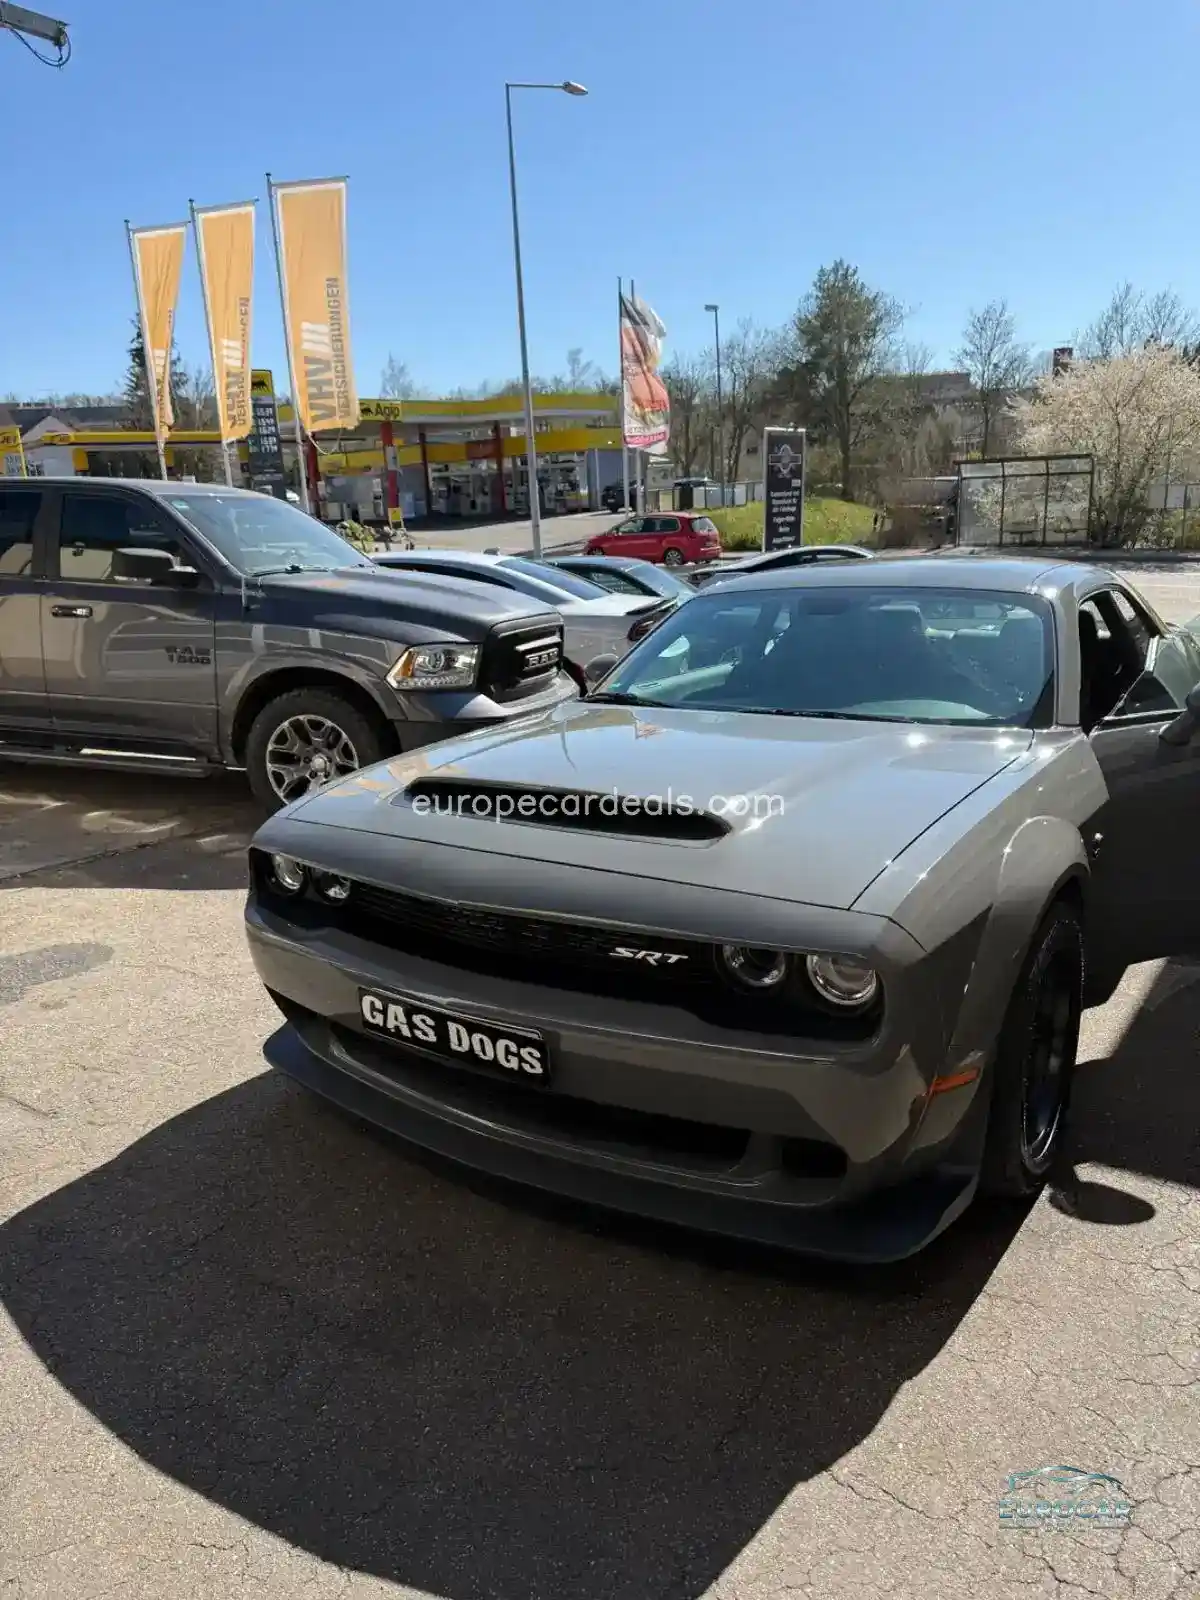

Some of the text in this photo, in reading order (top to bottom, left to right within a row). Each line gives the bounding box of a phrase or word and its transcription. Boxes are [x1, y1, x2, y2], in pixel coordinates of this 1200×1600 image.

[326, 277, 350, 418] VERSICHERUNGEN
[304, 356, 337, 424] VHV
[375, 402, 399, 420] Agip
[608, 947, 689, 966] SRT
[361, 995, 543, 1075] GAS DOGS
